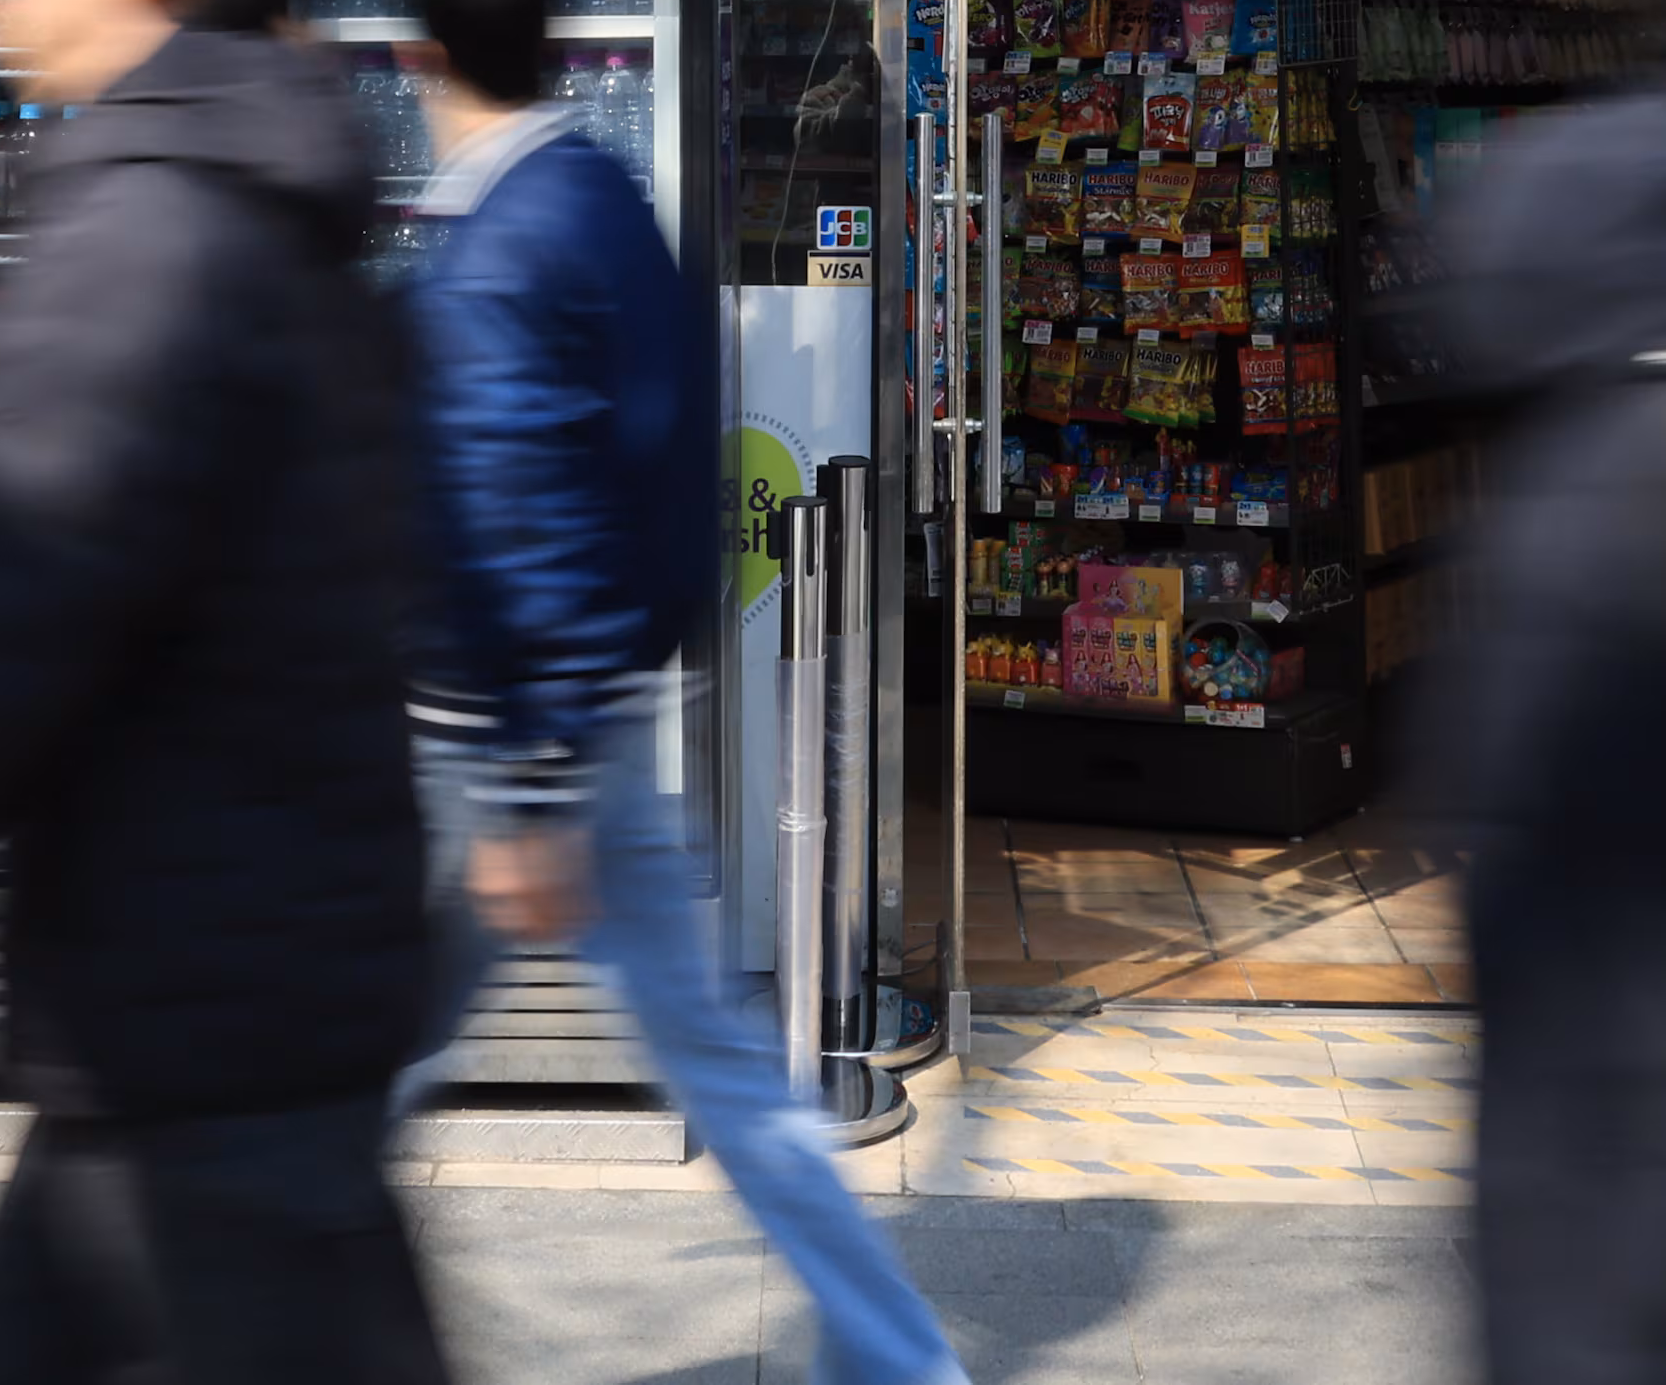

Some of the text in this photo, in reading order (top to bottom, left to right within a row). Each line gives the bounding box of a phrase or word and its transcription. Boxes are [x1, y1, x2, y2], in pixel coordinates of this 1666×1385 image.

[1032, 171, 1077, 185] HARIBO
[1144, 171, 1190, 186] HARIBO
[821, 220, 867, 236] JCB
[817, 263, 864, 280] VISA
[1127, 263, 1174, 277] HARIBO
[1181, 261, 1229, 277] HARIBO
[1084, 348, 1123, 362] HARIBO
[1137, 349, 1181, 365] HARIBO
